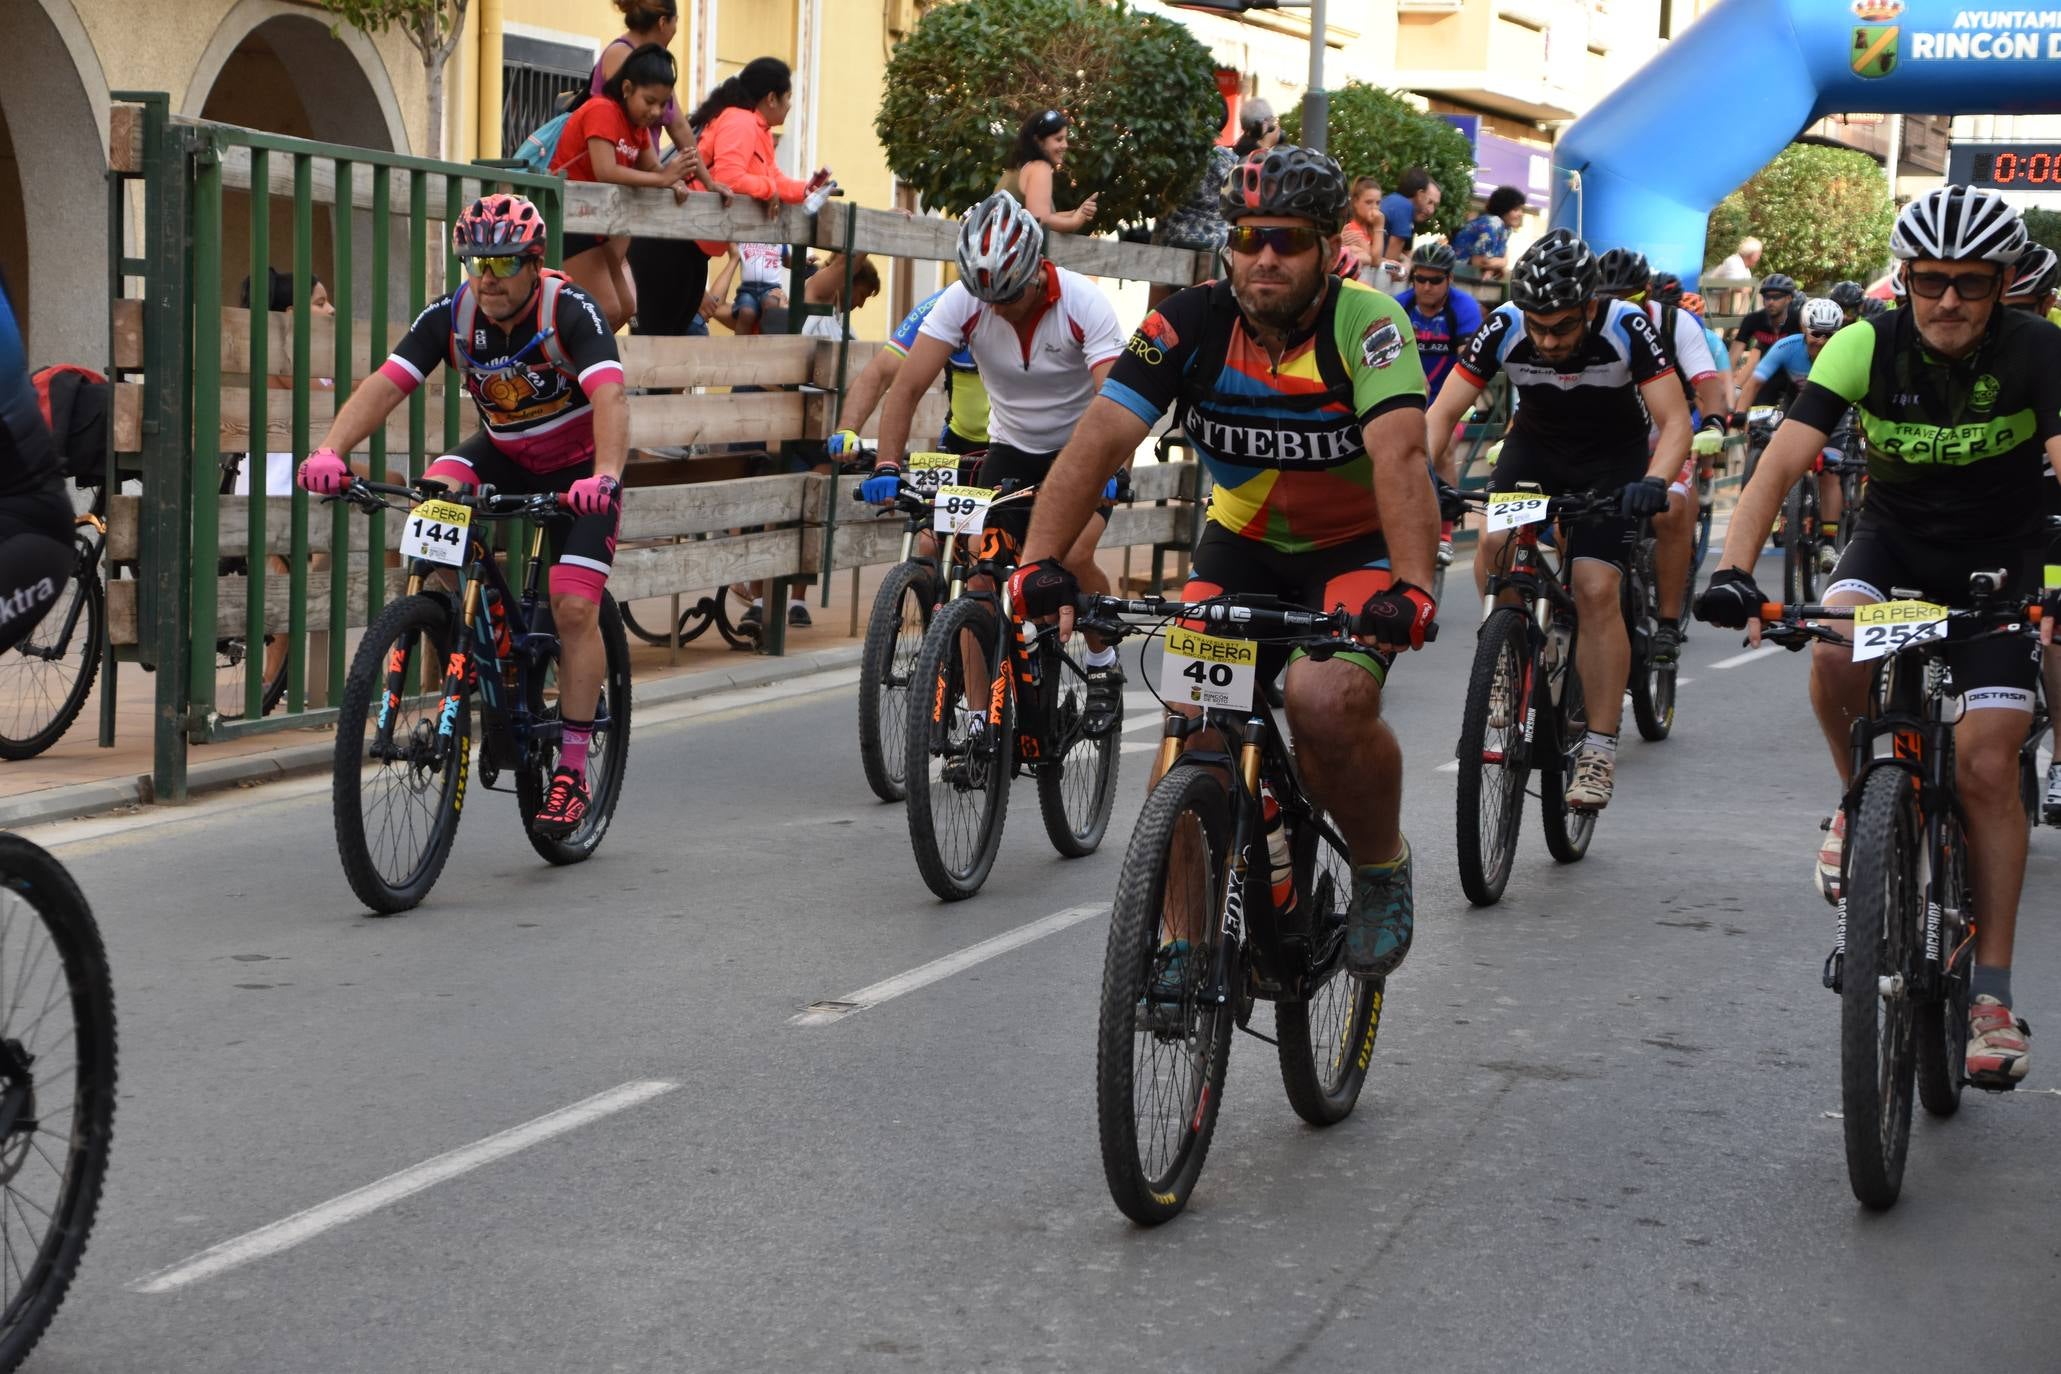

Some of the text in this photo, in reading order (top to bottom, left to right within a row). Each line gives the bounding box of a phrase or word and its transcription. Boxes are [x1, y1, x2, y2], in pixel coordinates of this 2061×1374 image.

[1911, 32, 2039, 60] RINCÓN
[1471, 315, 1504, 353] PRO
[1632, 316, 1664, 356] PRO
[1895, 426, 1985, 442] TRAVESIA BTT
[928, 457, 957, 467] PERA
[915, 470, 953, 487] 292
[946, 496, 976, 516] 89
[962, 488, 993, 497] PERA
[431, 506, 466, 523] PERA
[1494, 500, 1542, 516] 239
[413, 519, 460, 546] 144
[1860, 608, 1885, 622] LA
[1890, 606, 1942, 620] PERA
[1170, 634, 1252, 661] LA PERA
[1864, 622, 1937, 647] 253
[1183, 660, 1234, 687] 40
[1968, 691, 2027, 702] DISTASA
[1524, 706, 1537, 744] ROCKSHOX
[454, 736, 470, 812] MAXXIS
[1221, 868, 1246, 937] FOX
[1925, 901, 1942, 961] ROCKSHOX
[1358, 991, 1382, 1072] MAXXIS
